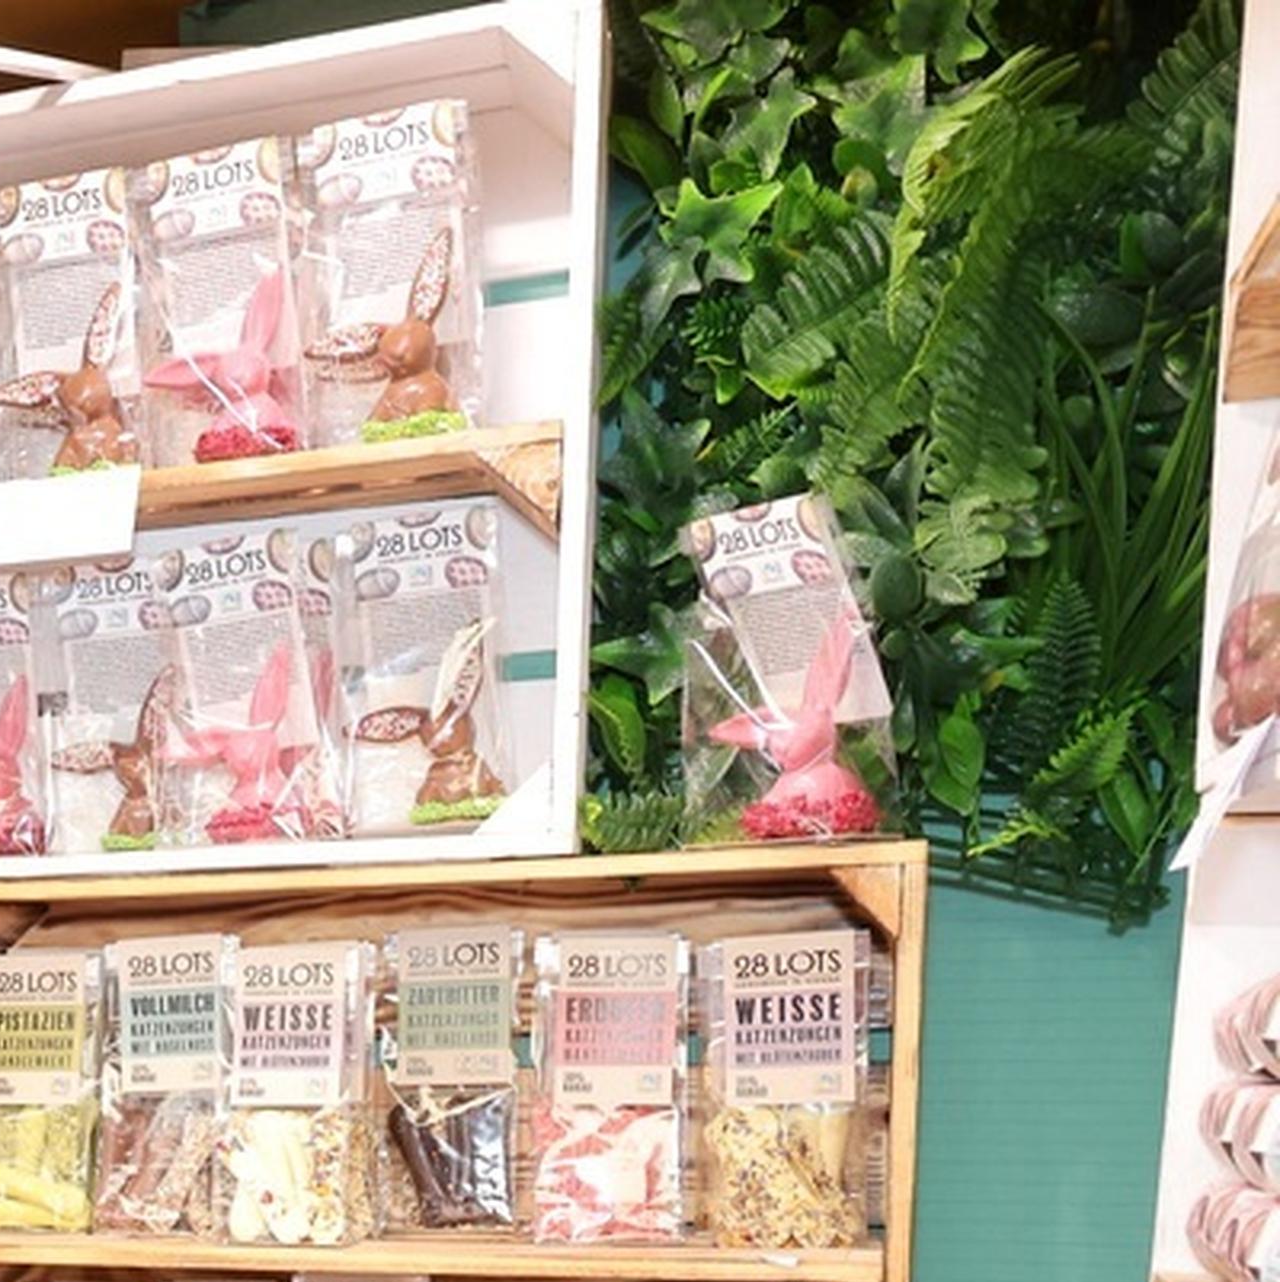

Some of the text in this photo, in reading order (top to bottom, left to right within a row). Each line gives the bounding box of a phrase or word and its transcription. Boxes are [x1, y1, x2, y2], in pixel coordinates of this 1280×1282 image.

[128, 952, 215, 977] 28 LOTS
[408, 942, 500, 966] 28 LOTS
[568, 953, 667, 978] 28 LOTS
[735, 949, 842, 977] 28 LOTS
[27, 971, 78, 992] LOTS
[244, 961, 334, 987] 28 LOTS
[130, 992, 215, 1017] VOLLMILCH
[735, 994, 841, 1025] WEISSE
[243, 1004, 332, 1031] WEISSE
